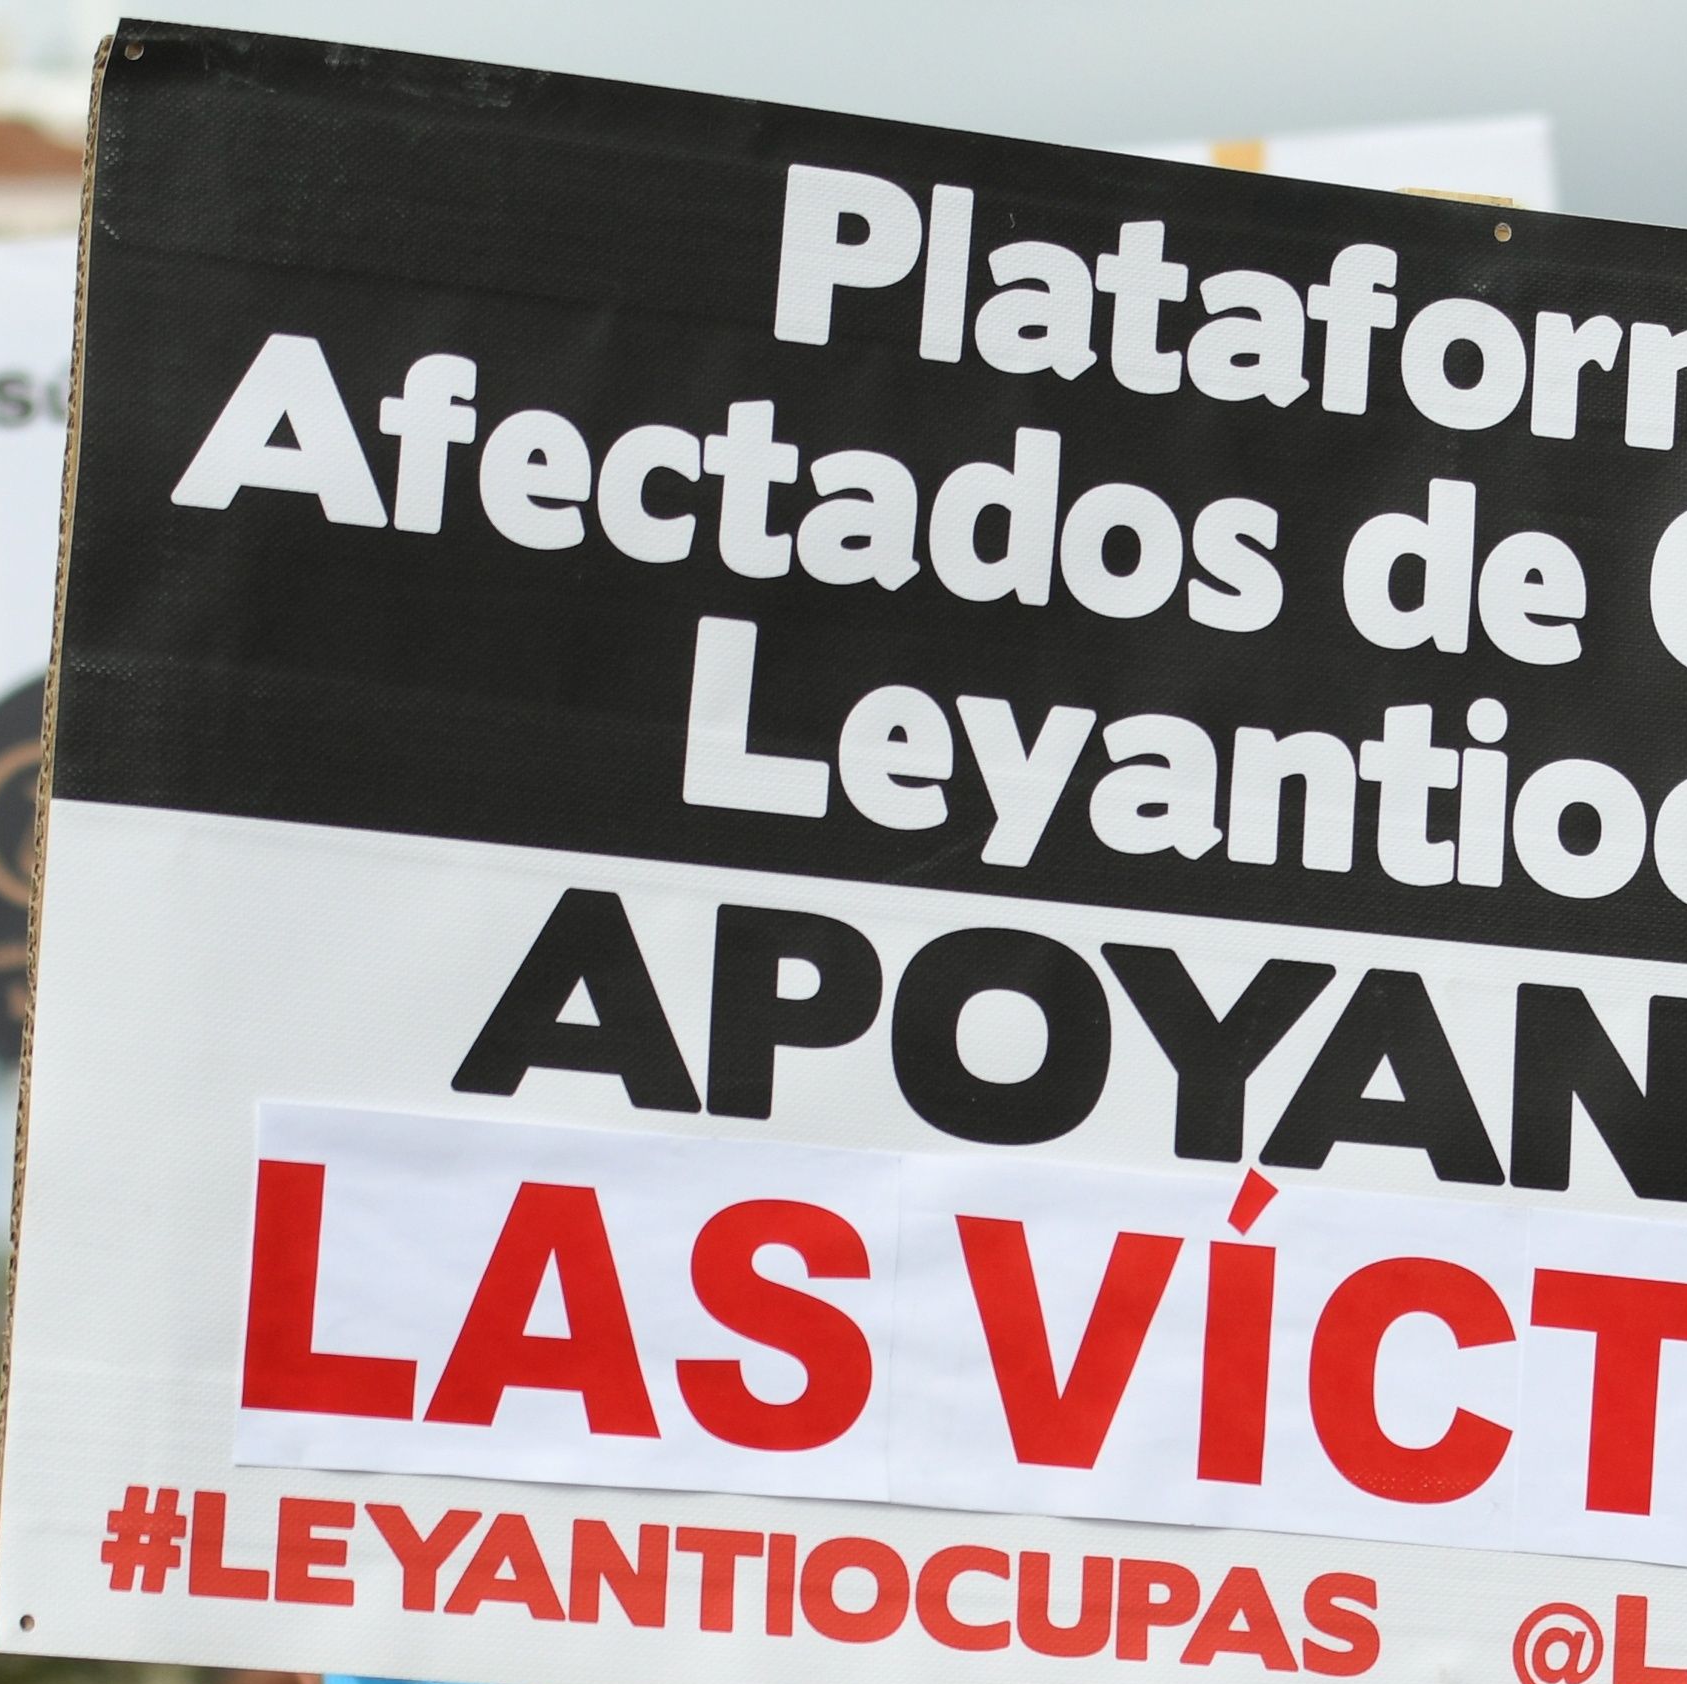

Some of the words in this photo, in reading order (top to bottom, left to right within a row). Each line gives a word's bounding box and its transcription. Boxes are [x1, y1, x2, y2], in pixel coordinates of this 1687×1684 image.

[171, 334, 1284, 633] Afectados
[1343, 478, 1587, 666] de
[242, 1160, 873, 1452] LAS
[102, 1487, 1380, 1677] #LEYANTIOCUPAS
